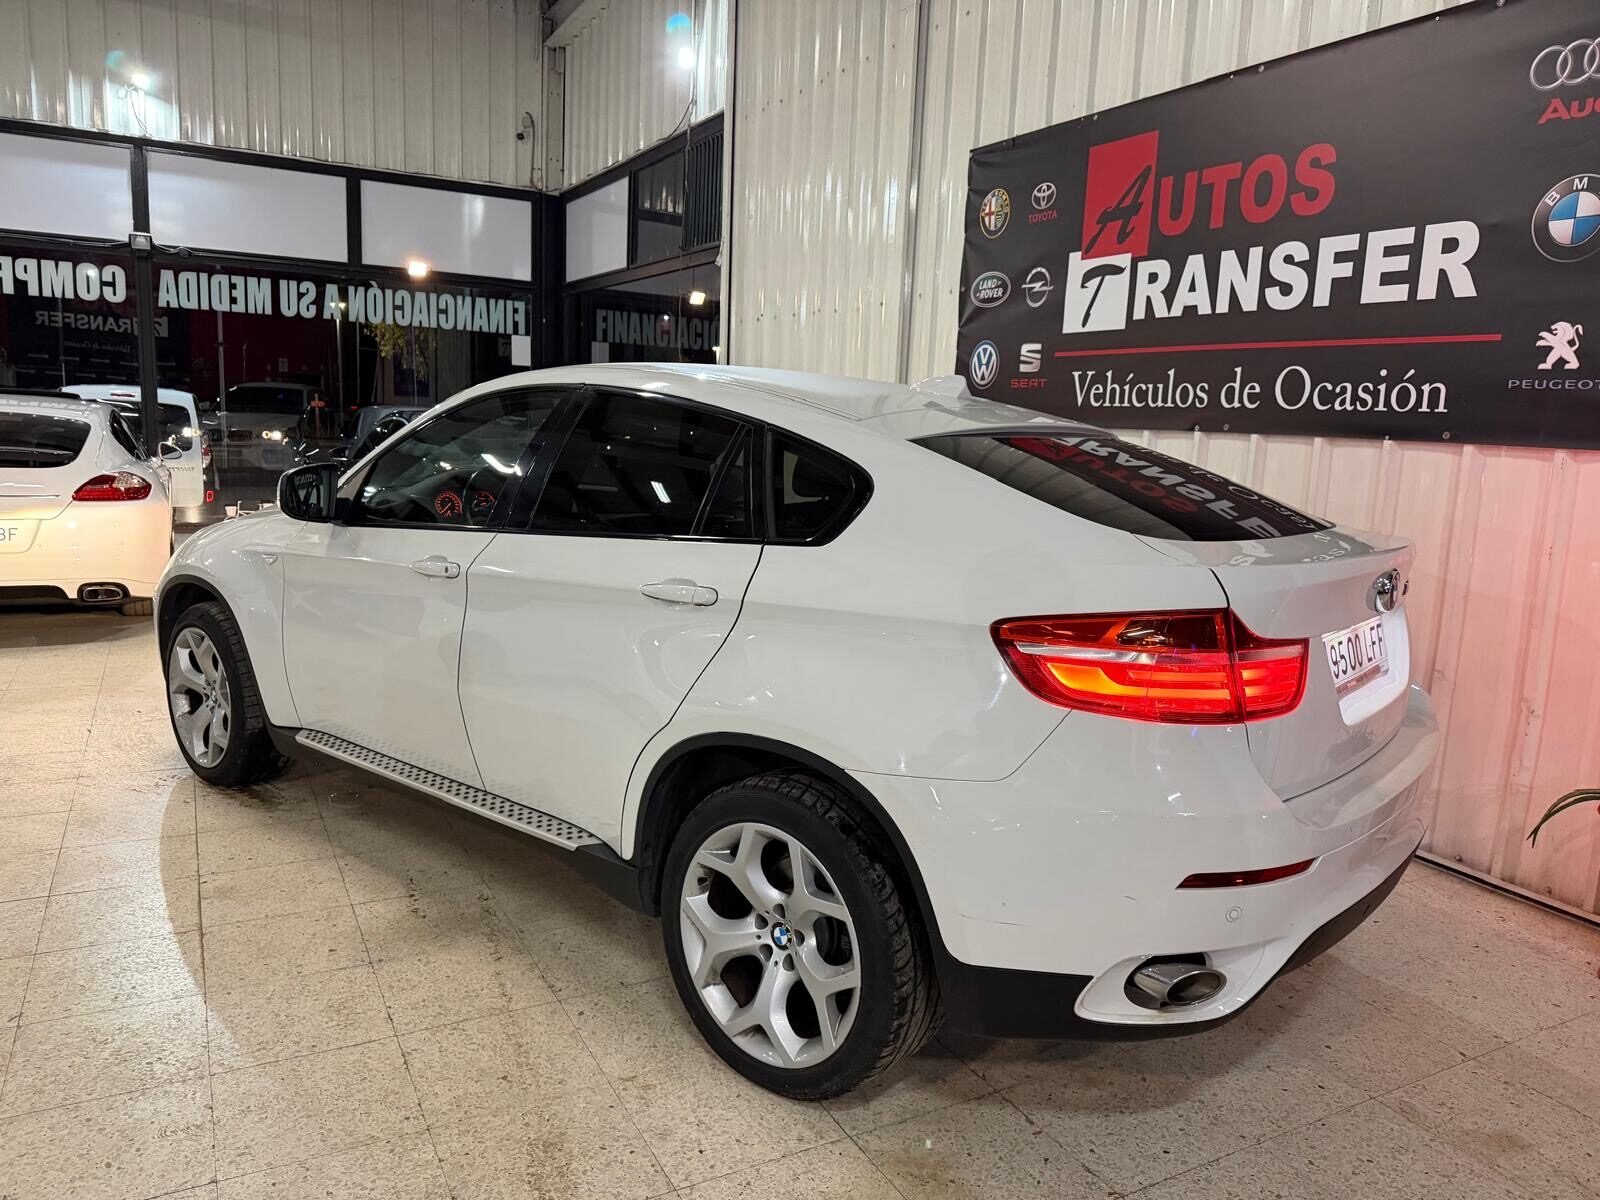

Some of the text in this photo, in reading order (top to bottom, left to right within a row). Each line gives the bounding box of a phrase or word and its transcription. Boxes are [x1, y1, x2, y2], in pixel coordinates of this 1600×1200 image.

[1537, 96, 1600, 125] Au
[1083, 142, 1337, 258] AUTOS
[1545, 176, 1600, 206] BM
[1028, 210, 1057, 225] TOYOTA
[979, 279, 998, 290] LAND
[1075, 220, 1481, 330] TRANSFER
[980, 288, 1004, 299] ROVER
[1010, 378, 1048, 388] SEAT
[1072, 366, 1449, 414] Vehículos de Ocasión
[1330, 635, 1363, 680] 9500
[1363, 623, 1383, 663] LFF
